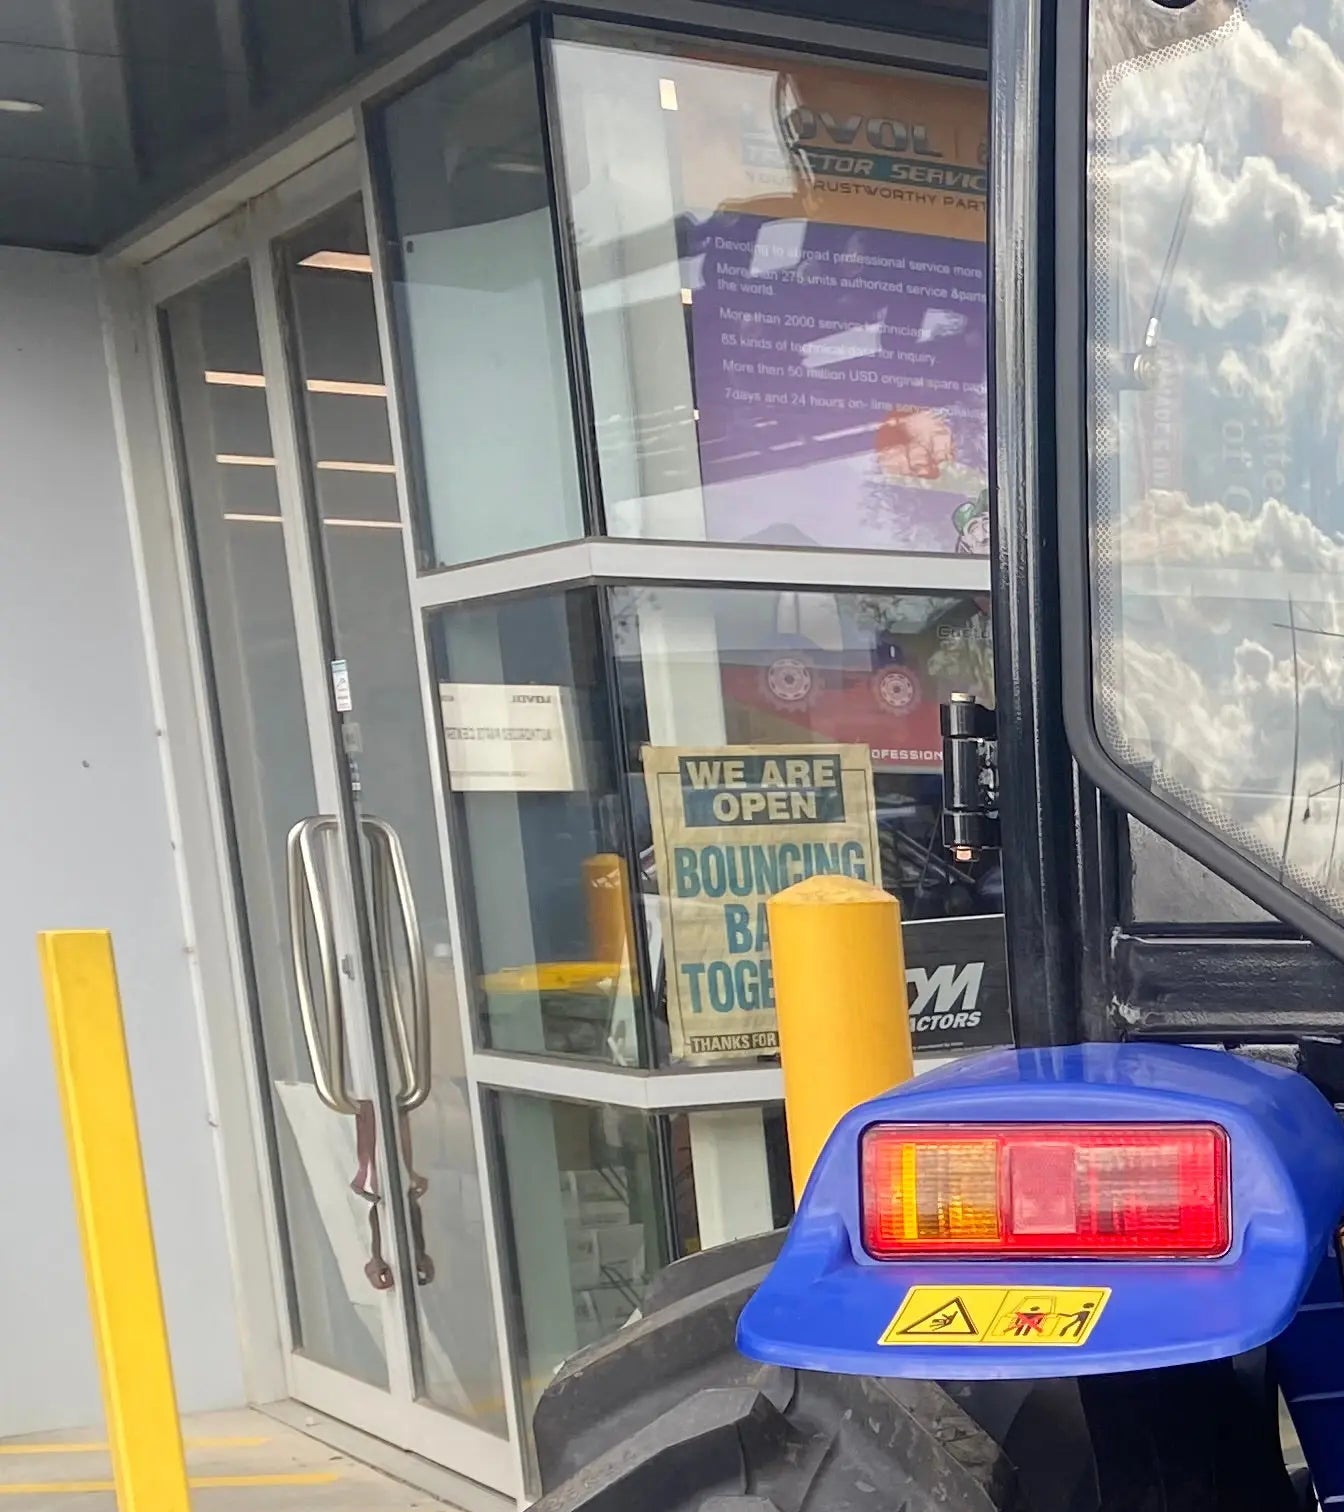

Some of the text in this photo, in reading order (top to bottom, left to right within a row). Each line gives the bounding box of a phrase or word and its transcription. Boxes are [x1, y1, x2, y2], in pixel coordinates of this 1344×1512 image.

[803, 179, 938, 207] RUSTWORTHY
[833, 251, 906, 269] professional
[909, 259, 950, 275] service
[953, 265, 983, 279] more
[718, 279, 737, 292] the
[807, 274, 838, 287] units
[840, 277, 903, 293] authorized
[906, 283, 948, 298] service
[720, 307, 753, 322] More
[754, 311, 781, 325] than
[784, 314, 815, 328] 2000
[740, 336, 772, 350] kinds
[775, 339, 788, 352] of
[723, 359, 754, 374] More
[757, 361, 784, 376] than
[807, 367, 846, 381] million
[849, 369, 878, 383] USD
[881, 373, 924, 388] original
[765, 391, 788, 404] and
[791, 393, 806, 406] 24
[810, 395, 845, 409] hours
[686, 758, 836, 789] WE ARE
[712, 791, 817, 822] OPEN
[674, 841, 866, 898] BOUNCING
[691, 1032, 777, 1053] THANKS FOR
